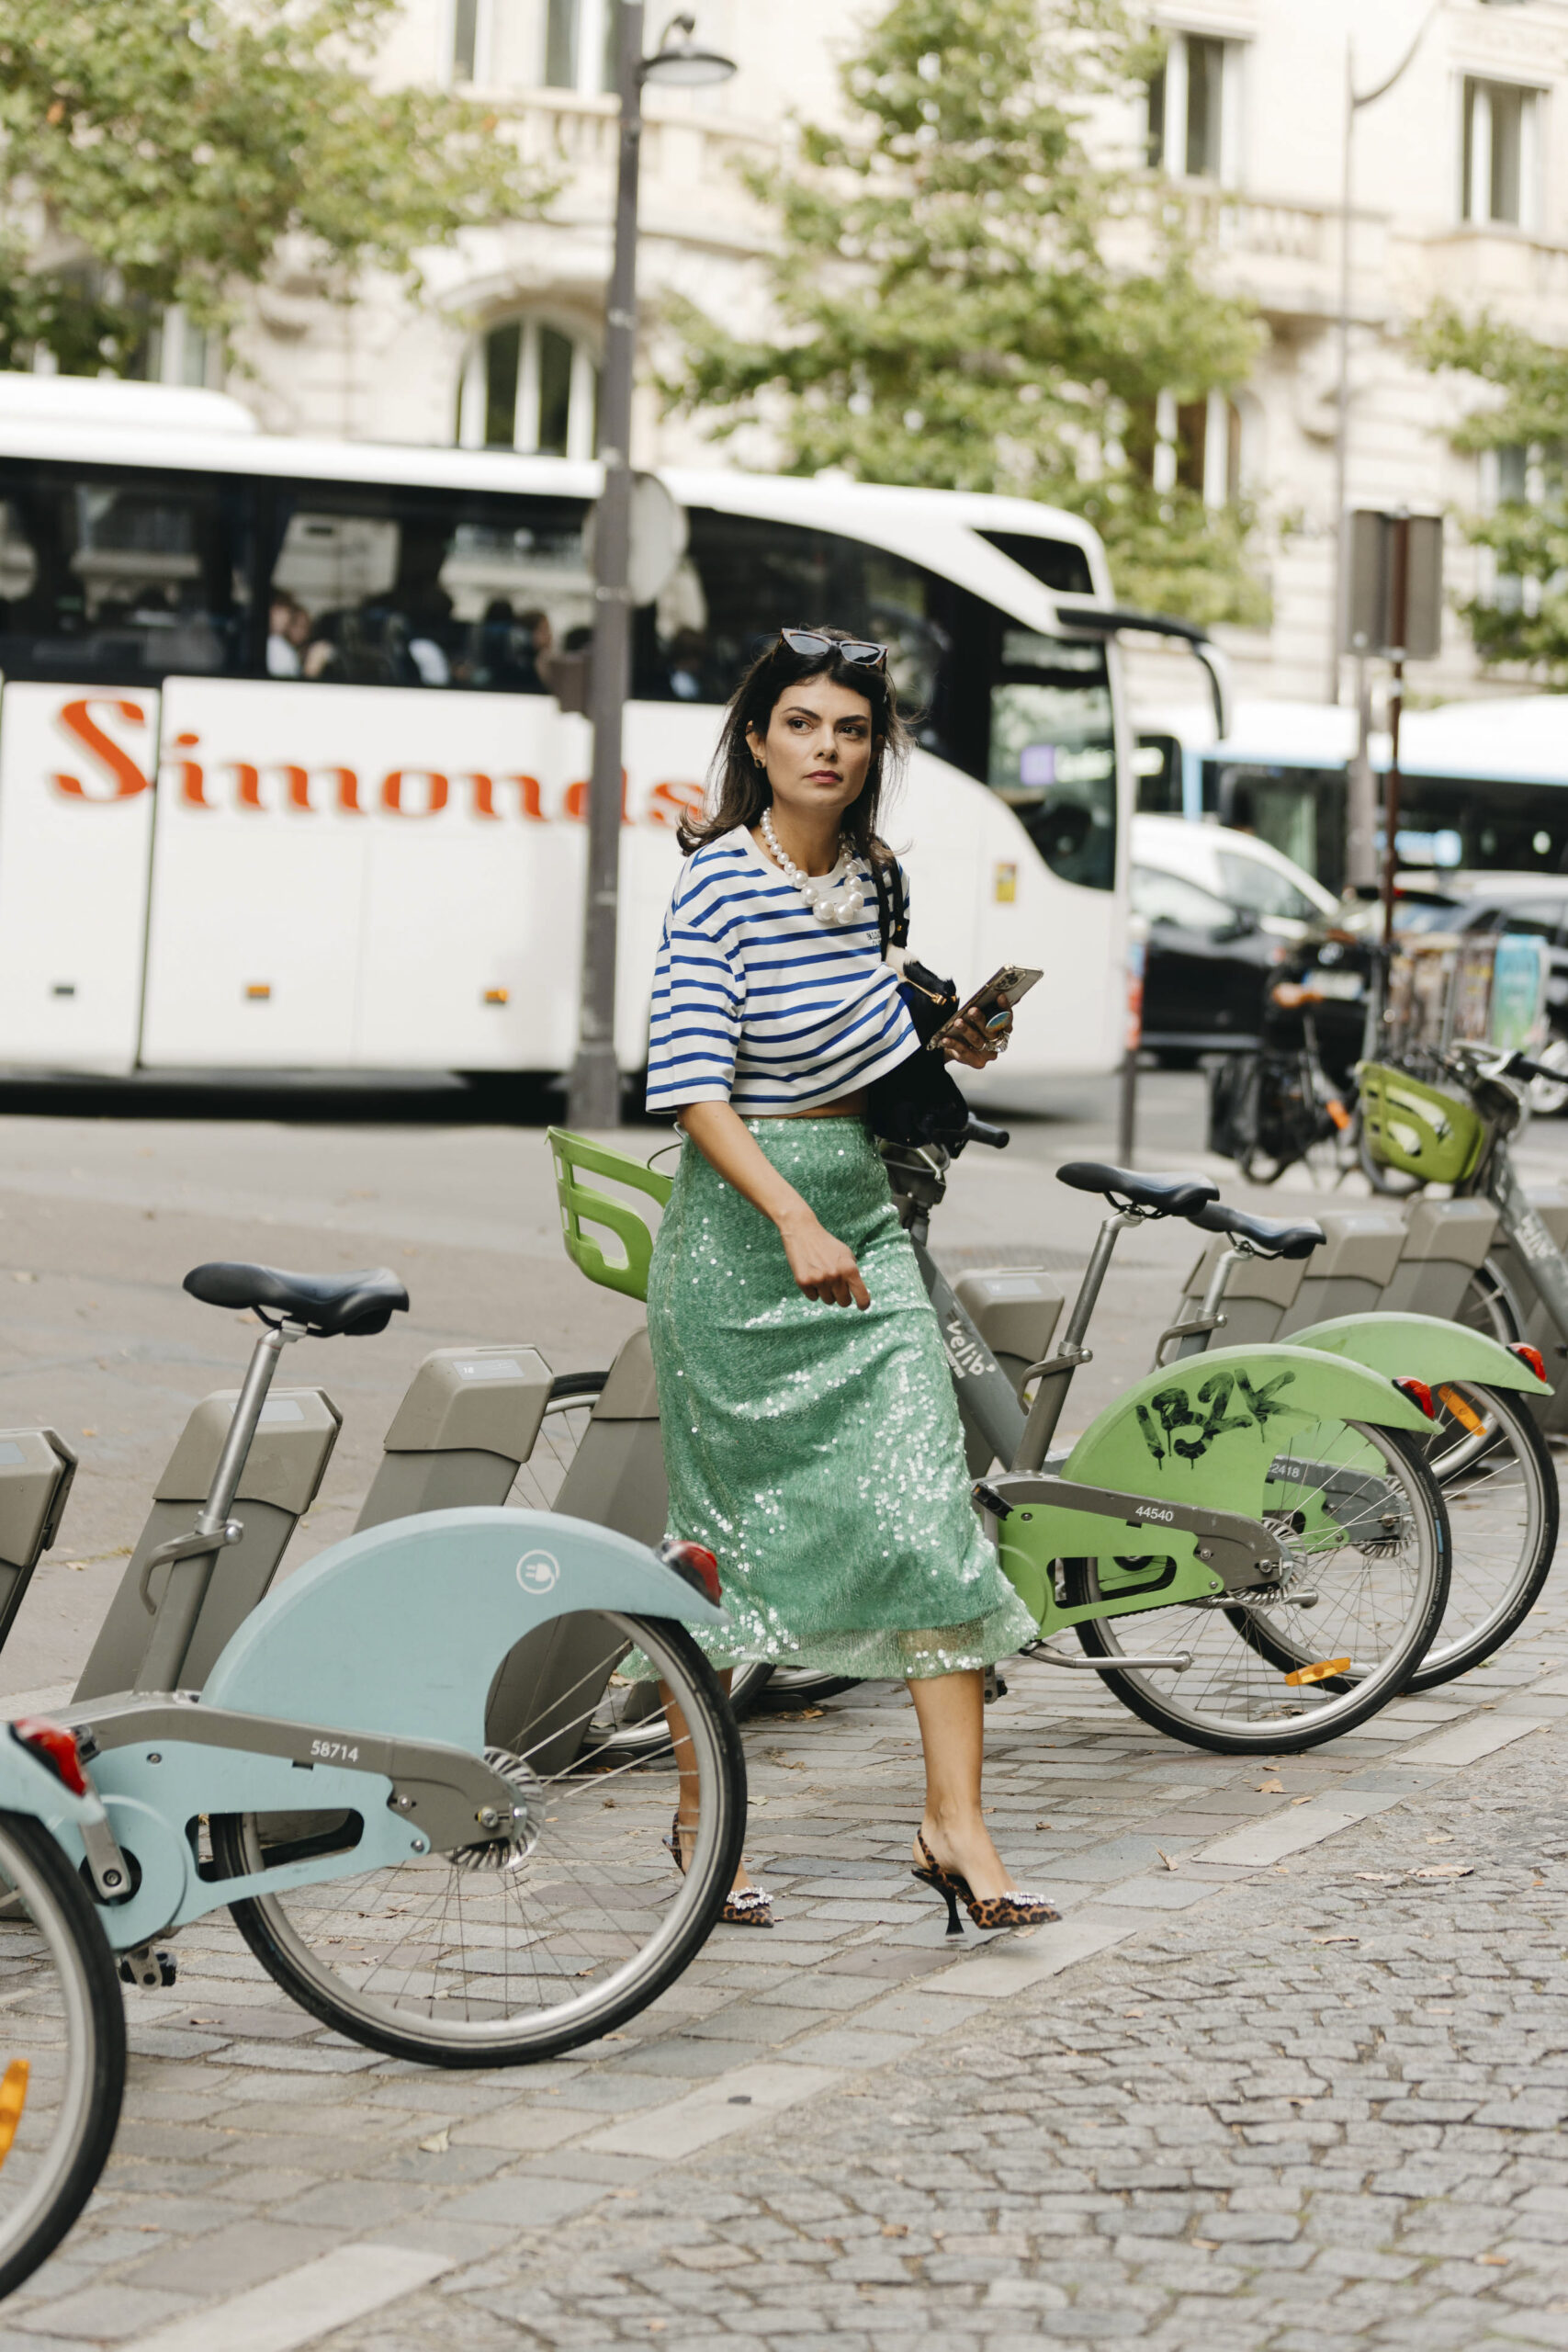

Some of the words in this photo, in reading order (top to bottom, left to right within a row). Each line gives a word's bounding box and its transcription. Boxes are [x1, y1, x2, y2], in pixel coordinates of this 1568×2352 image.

[1268, 1463, 1300, 1477] 2418
[1134, 1506, 1174, 1522] 44540
[310, 1739, 358, 1762] 58714
